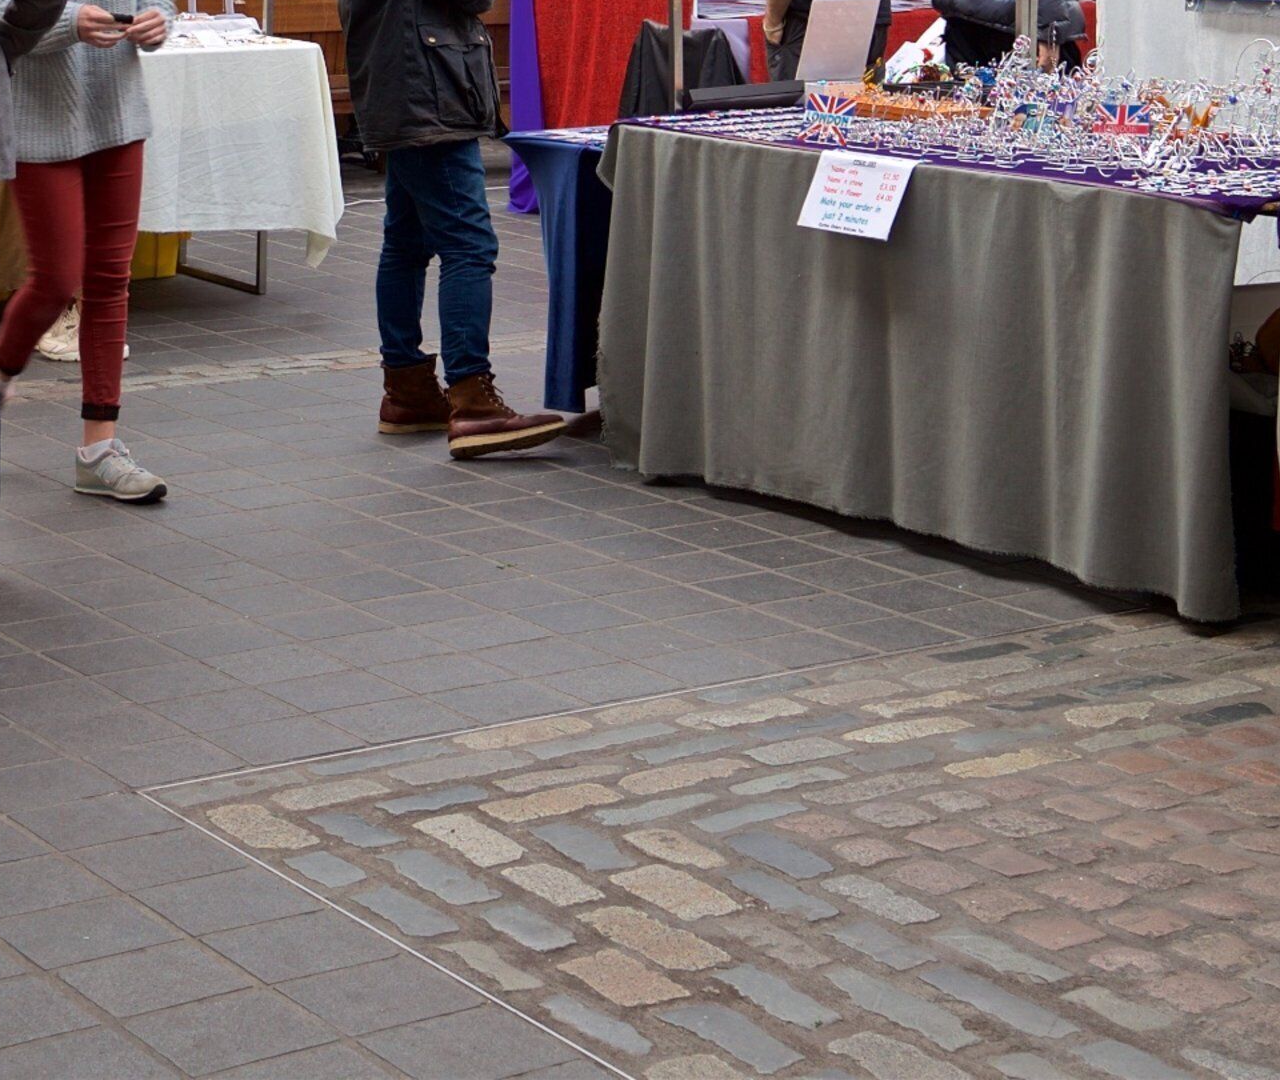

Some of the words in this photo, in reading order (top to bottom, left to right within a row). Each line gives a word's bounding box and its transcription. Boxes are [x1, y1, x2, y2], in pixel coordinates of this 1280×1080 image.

[806, 110, 849, 128] LONDON
[819, 197, 837, 207] Make
[839, 201, 854, 210] your
[855, 204, 874, 213] order
[845, 216, 869, 226] minutes
